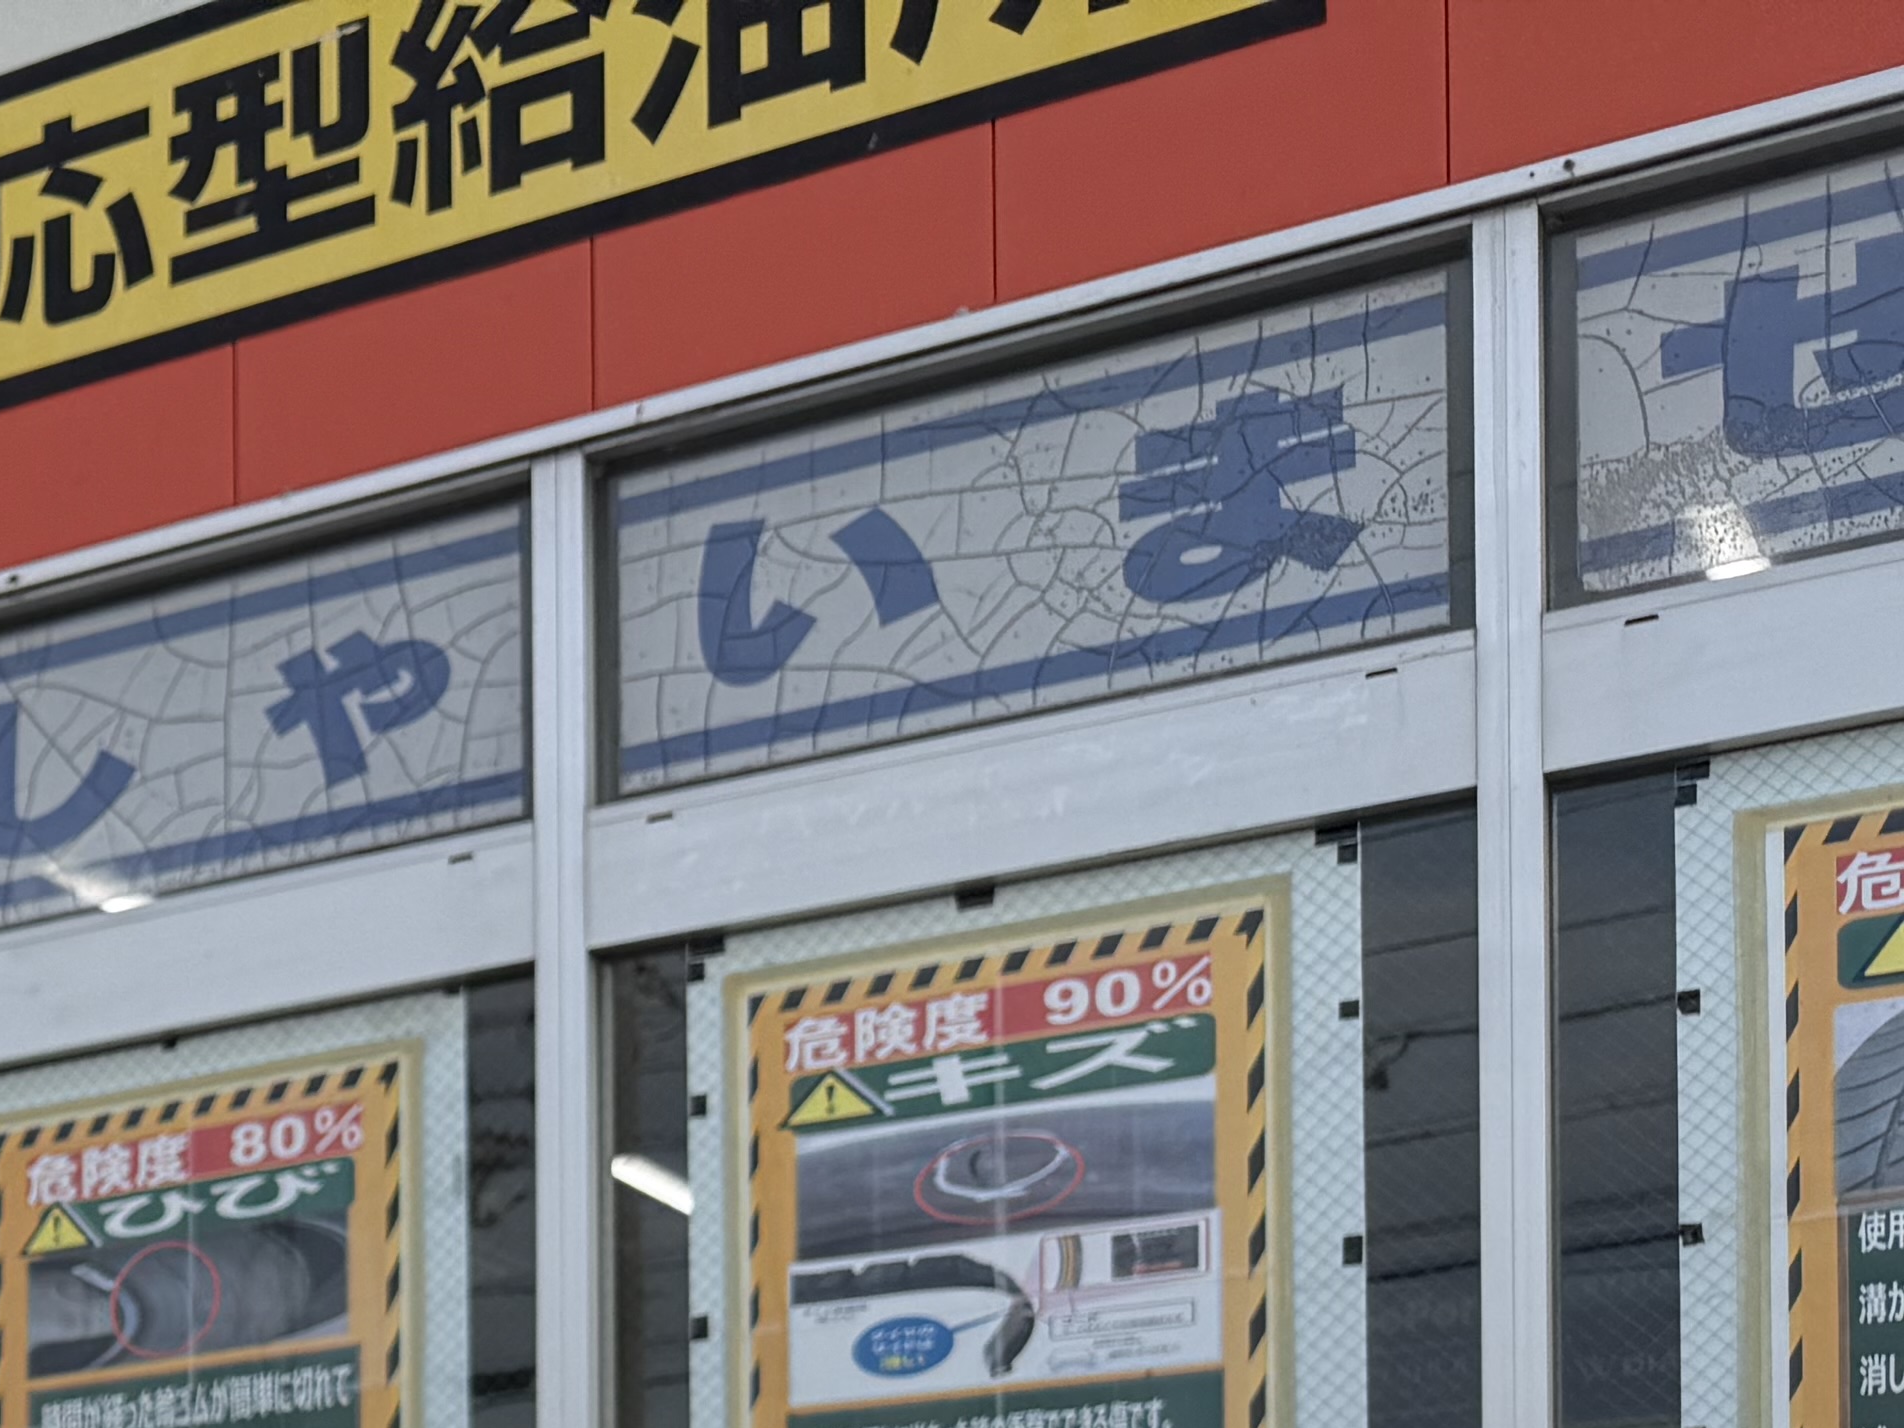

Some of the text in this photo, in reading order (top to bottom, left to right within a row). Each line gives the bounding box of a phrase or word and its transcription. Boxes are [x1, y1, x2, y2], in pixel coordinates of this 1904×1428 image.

[783, 954, 1212, 1071] 危険度 90%
[884, 1016, 1201, 1105] キズ
[26, 1103, 364, 1206] 危険度 80%
[102, 1160, 341, 1239] ひび
